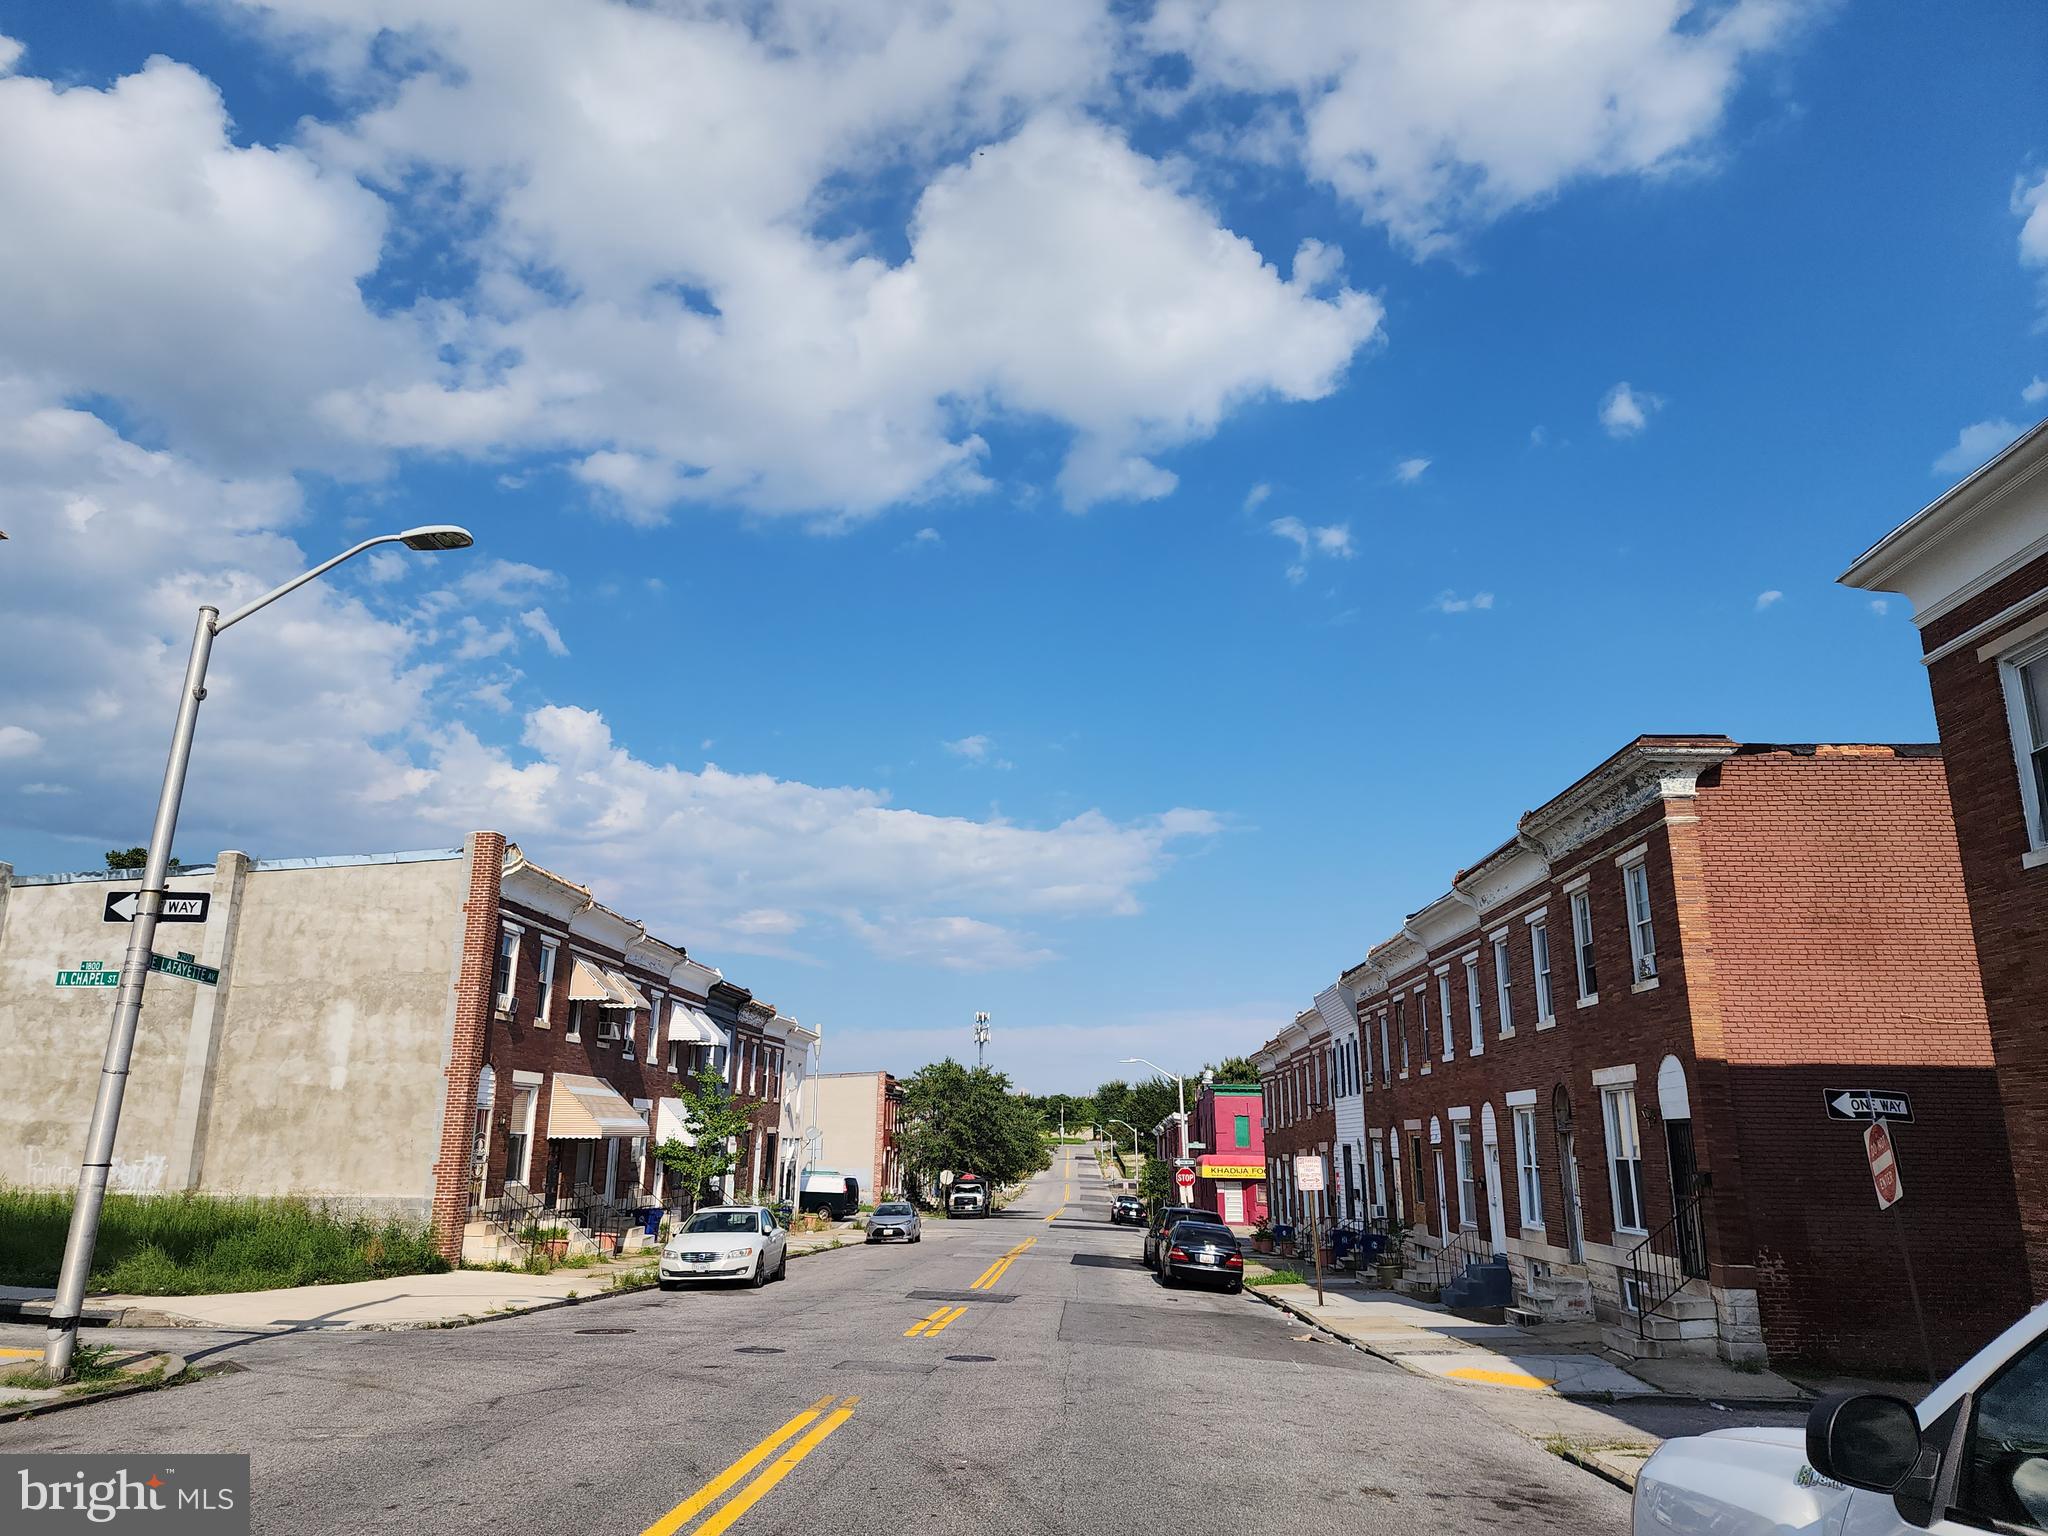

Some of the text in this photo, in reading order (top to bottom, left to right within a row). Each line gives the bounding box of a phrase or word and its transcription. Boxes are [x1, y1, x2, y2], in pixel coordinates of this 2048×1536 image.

[168, 901, 198, 914] WAY
[85, 962, 101, 971] 1800
[160, 957, 207, 981] LAFAYETTE
[59, 972, 69, 985] N.
[70, 972, 105, 985] CHAPEL
[1851, 1099, 1902, 1112] ONE WAY
[1177, 1173, 1194, 1182] STOP
[1210, 1167, 1249, 1175] KHADIJA
